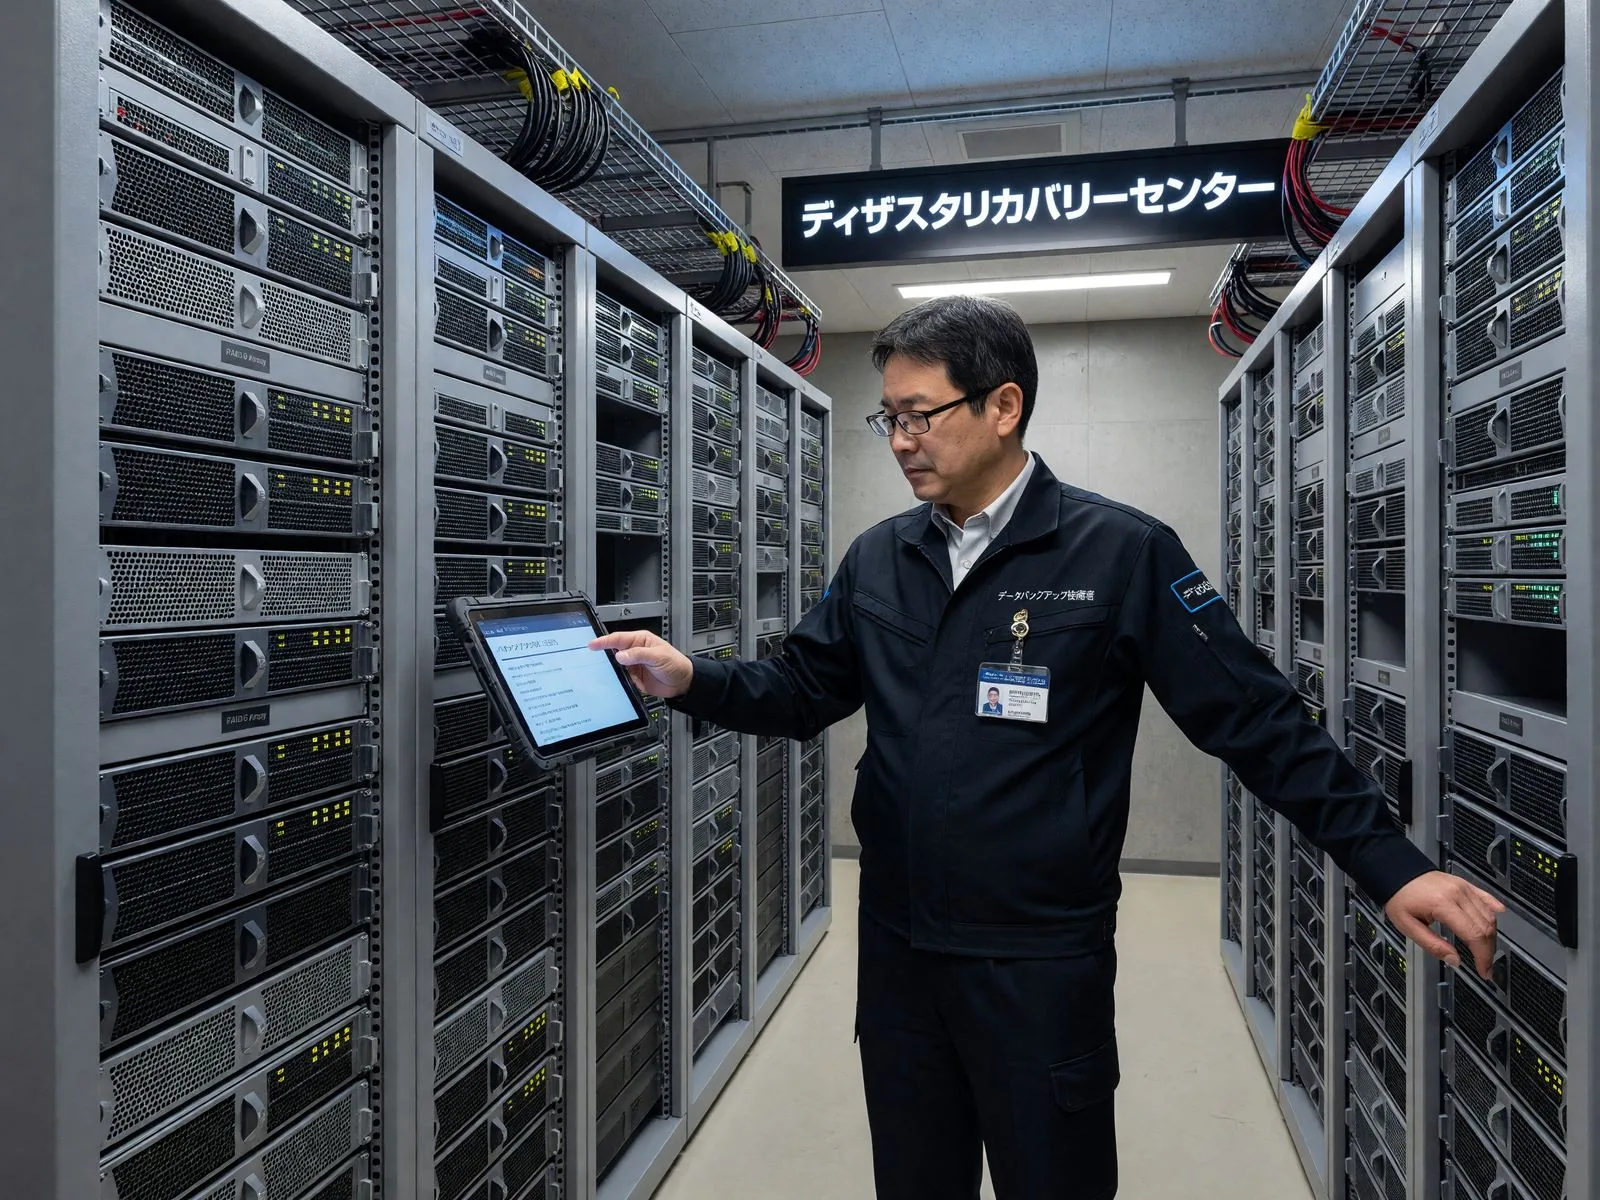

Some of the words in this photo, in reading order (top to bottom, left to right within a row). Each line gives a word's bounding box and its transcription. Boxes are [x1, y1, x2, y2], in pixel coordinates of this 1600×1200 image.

[802, 171, 1275, 238] ディザスタリカバリーセンター
[226, 715, 243, 725] RAID
